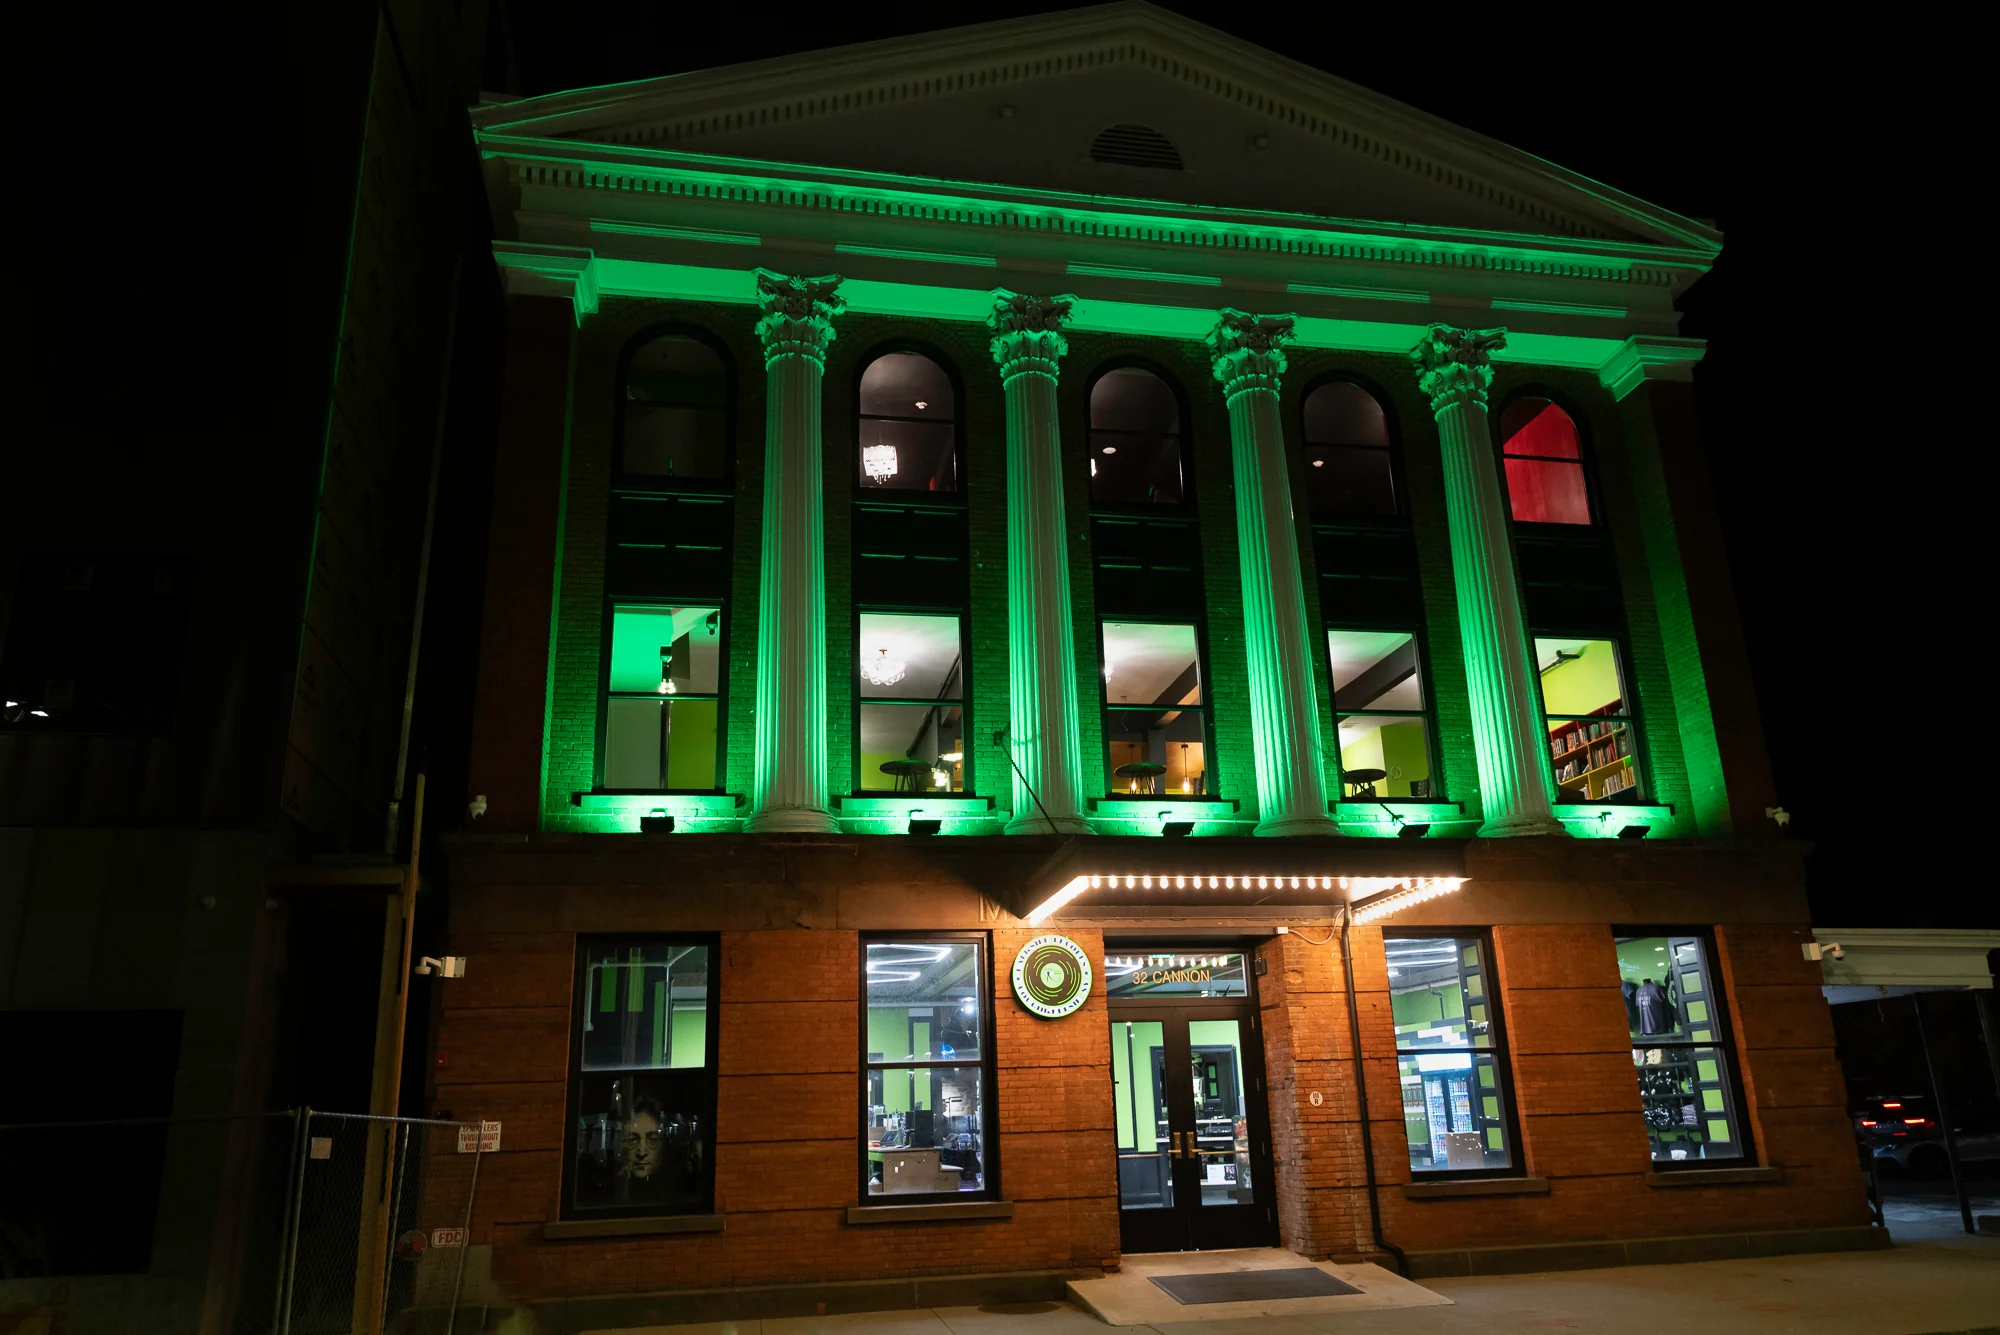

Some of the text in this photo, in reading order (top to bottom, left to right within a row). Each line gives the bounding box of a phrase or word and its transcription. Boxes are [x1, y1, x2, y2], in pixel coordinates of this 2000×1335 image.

[1132, 969, 1211, 985] 32 CANNON
[438, 1231, 461, 1245] FDC
